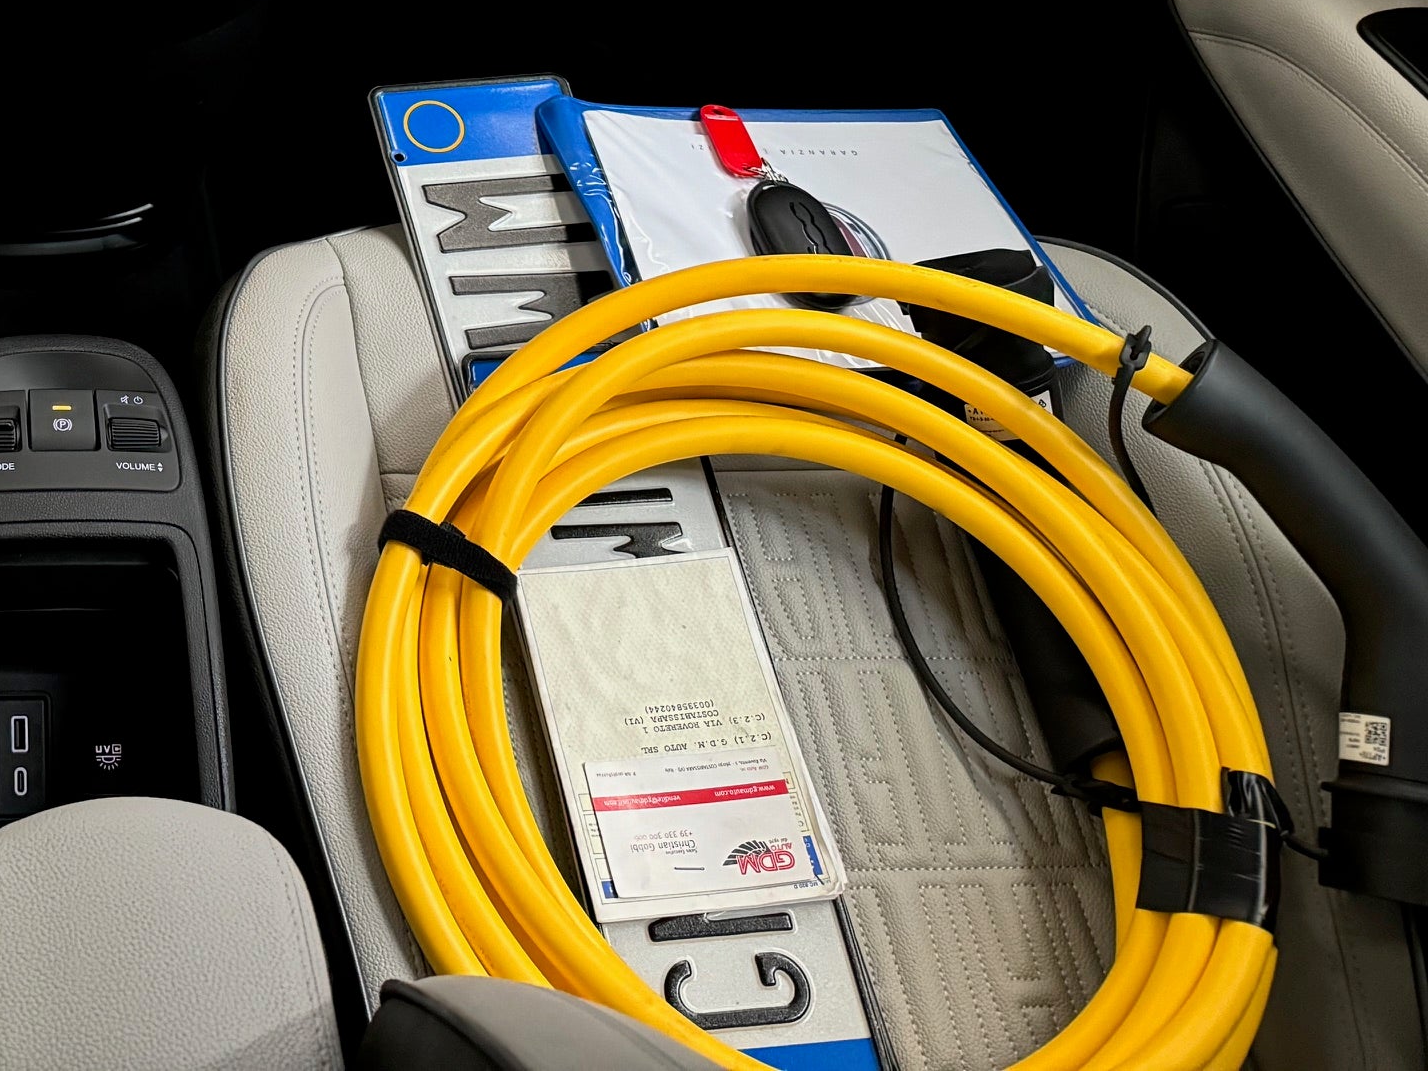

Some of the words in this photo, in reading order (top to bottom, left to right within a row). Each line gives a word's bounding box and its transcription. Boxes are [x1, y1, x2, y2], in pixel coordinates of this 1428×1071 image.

[116, 462, 156, 472] VOLUME
[623, 716, 644, 726] (VI)
[704, 719, 722, 727] VIA
[728, 712, 765, 725] (C.2.3)
[642, 726, 648, 734] 1
[653, 720, 699, 731] ROVERETO
[693, 738, 727, 748] G.D.M.
[734, 731, 772, 745] (C.2.1)
[641, 746, 659, 755] SRL
[664, 743, 687, 752] AUTO
[714, 784, 775, 797] www.gdmauto.com
[630, 843, 655, 853] Gobbi
[657, 839, 696, 850] Christian
[771, 842, 792, 851] AUTO
[736, 851, 795, 875] GDM
